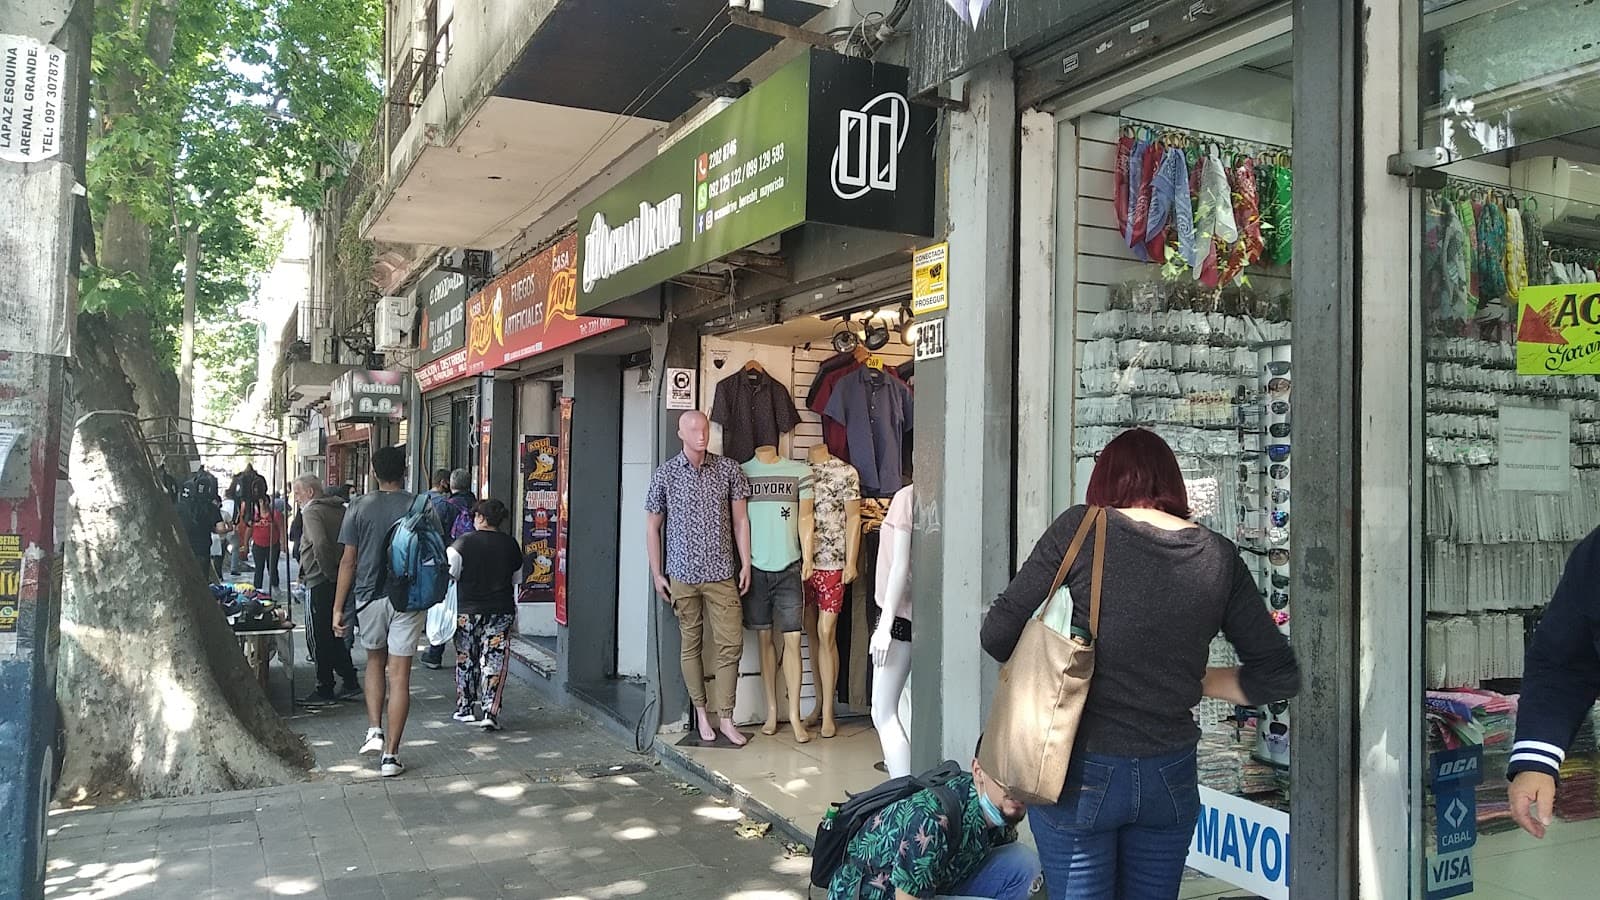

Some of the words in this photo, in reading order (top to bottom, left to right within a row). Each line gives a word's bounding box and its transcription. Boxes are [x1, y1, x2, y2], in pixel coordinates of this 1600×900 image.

[4, 47, 17, 103] ESQUINA
[25, 47, 38, 101] GRANDE.
[47, 54, 59, 98] 307875
[45, 101, 56, 124] 097
[1, 106, 13, 148] LAPAZ
[20, 105, 33, 156] ARENAL
[42, 127, 54, 153] TEL:
[759, 149, 771, 172] 129
[771, 142, 784, 165] 593
[552, 250, 570, 272] CASA
[915, 249, 945, 263] CONECTADA
[510, 272, 535, 303] FUEGOS
[915, 294, 945, 308] PROSEGUR
[504, 301, 543, 337] ARTIFICIALES
[357, 382, 400, 394] Fashion
[763, 483, 792, 495] YORK
[1439, 757, 1478, 776] OCA
[1197, 803, 1290, 888] MAYO
[1442, 830, 1472, 846] CABAL
[1433, 856, 1471, 883] VISA
